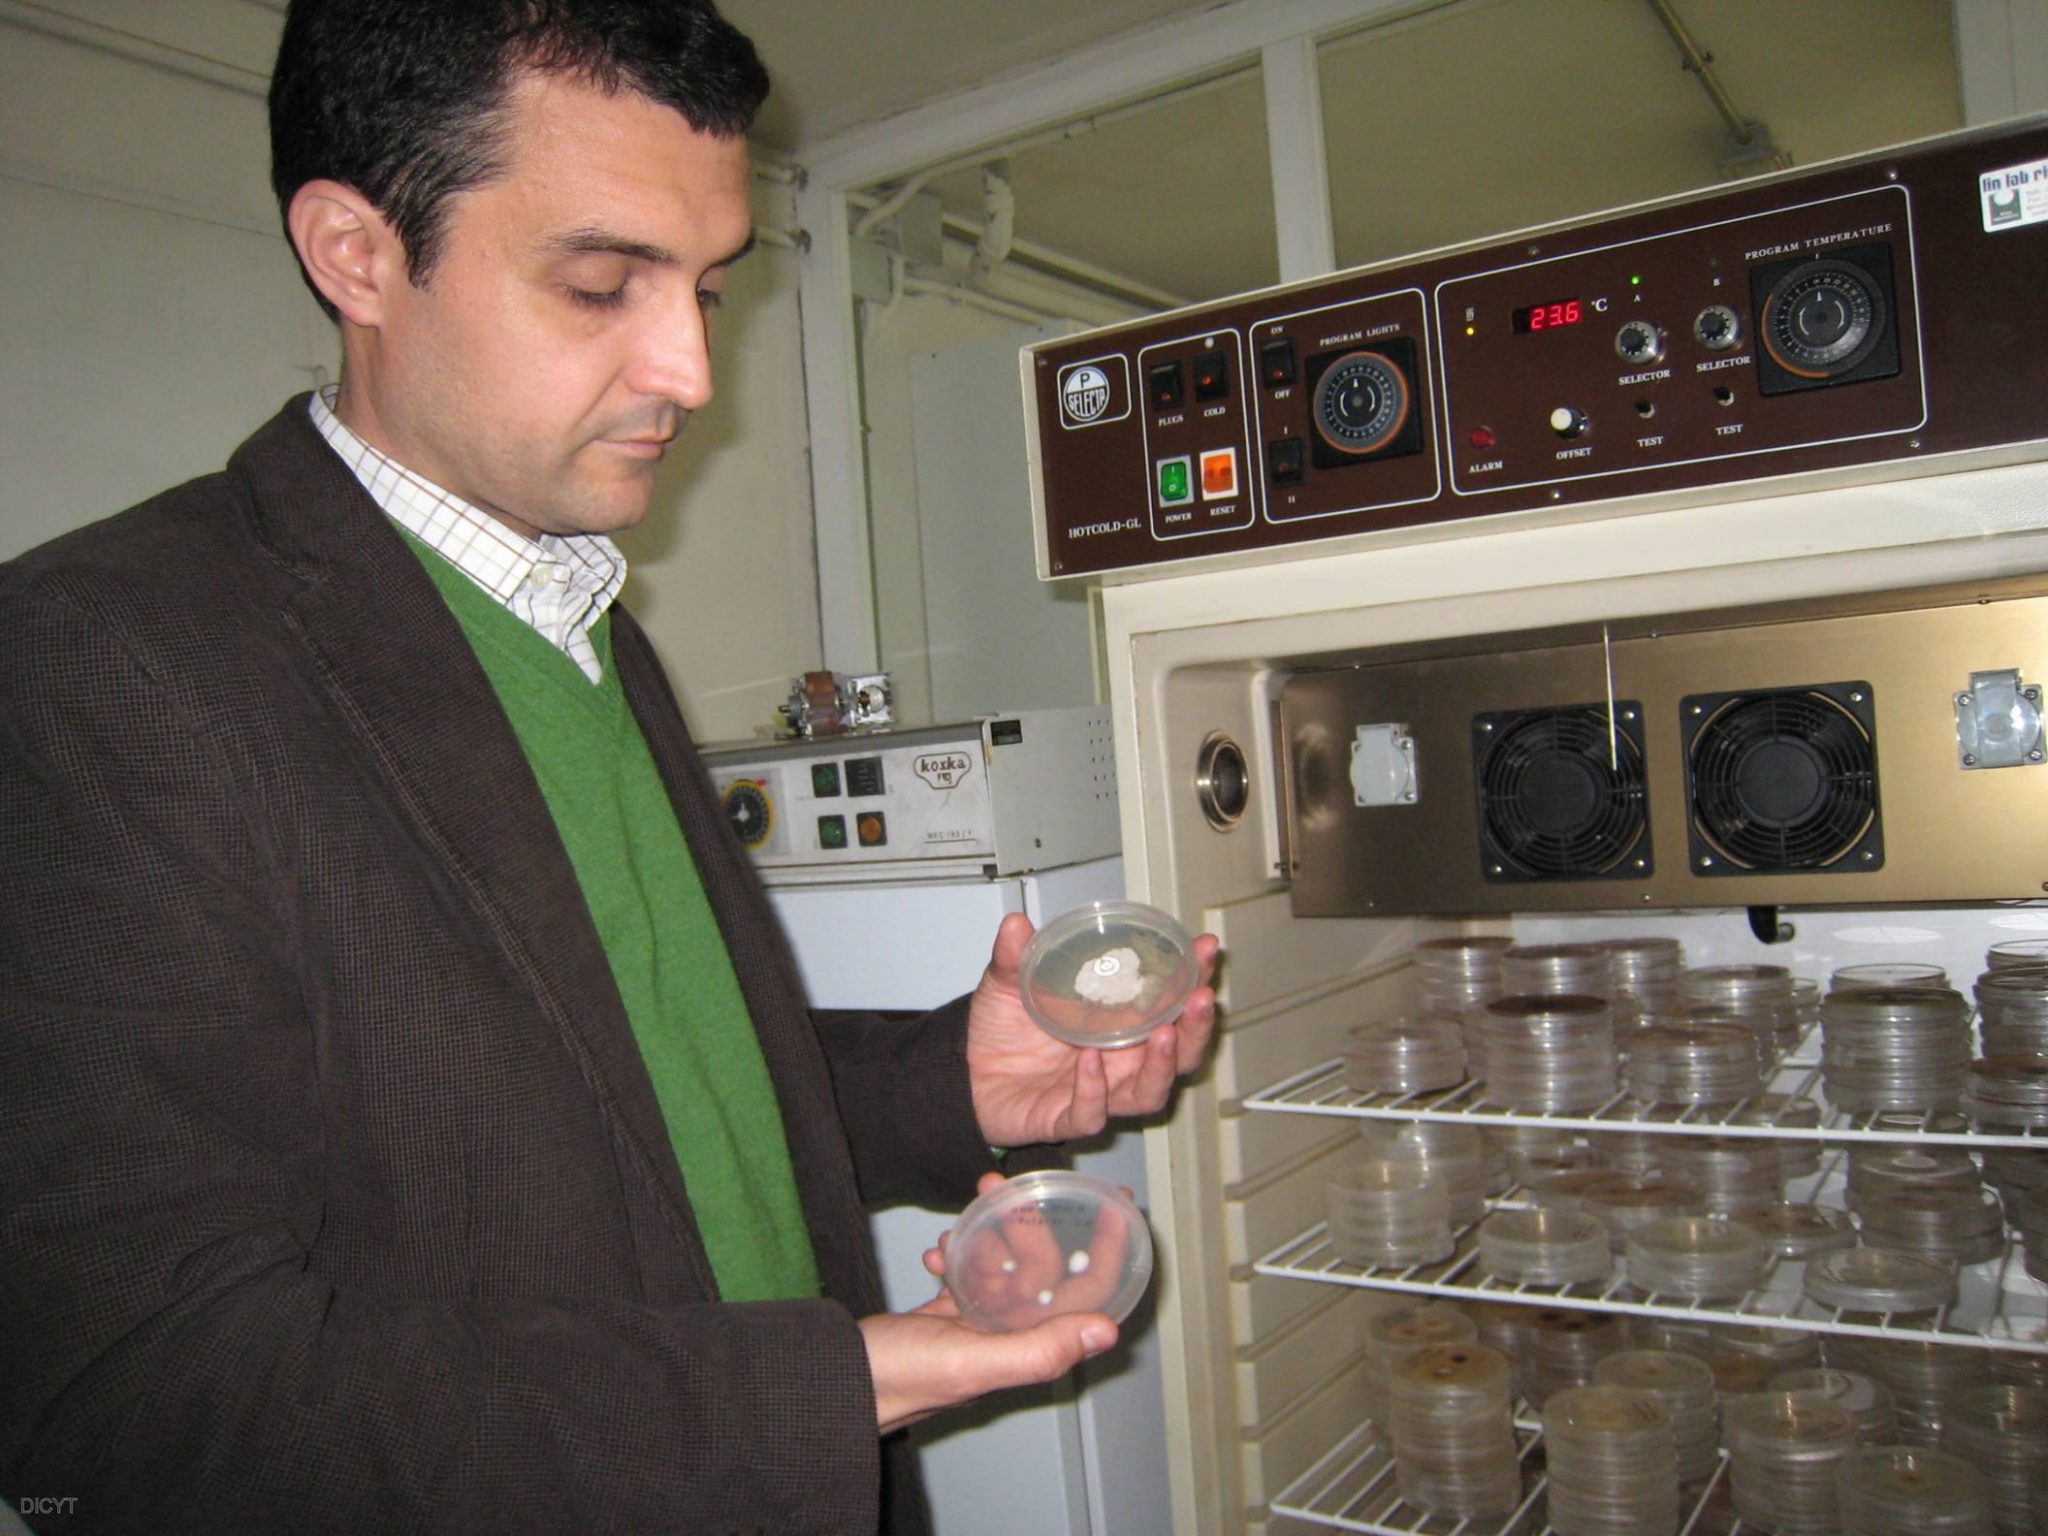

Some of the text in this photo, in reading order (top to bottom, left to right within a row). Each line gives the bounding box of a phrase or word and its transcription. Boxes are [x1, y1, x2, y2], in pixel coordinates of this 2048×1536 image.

[2005, 170, 2029, 188] lab
[1745, 223, 1893, 260] PROGRAM TEMPERATURE
[1713, 278, 1721, 287] B
[1634, 294, 1641, 302] A
[1531, 301, 1578, 329] 23.6
[1271, 326, 1284, 335] ON
[1320, 323, 1401, 347] PROGRAM LIGHTS
[1696, 355, 1751, 373] SELECTOR
[1080, 372, 1090, 389] P
[1618, 369, 1672, 386] SELECTOR
[1274, 389, 1291, 399] OFF
[1203, 406, 1226, 417] COLD
[1158, 415, 1184, 427] PLUGS
[1715, 423, 1744, 436] TEST
[1637, 435, 1664, 448] TEST
[1556, 447, 1592, 460] OFFSET
[1468, 460, 1503, 473] ALARM
[1210, 505, 1236, 516] RESET
[1165, 512, 1192, 523] POWER
[1068, 517, 1142, 539] HOTCOLD-GL
